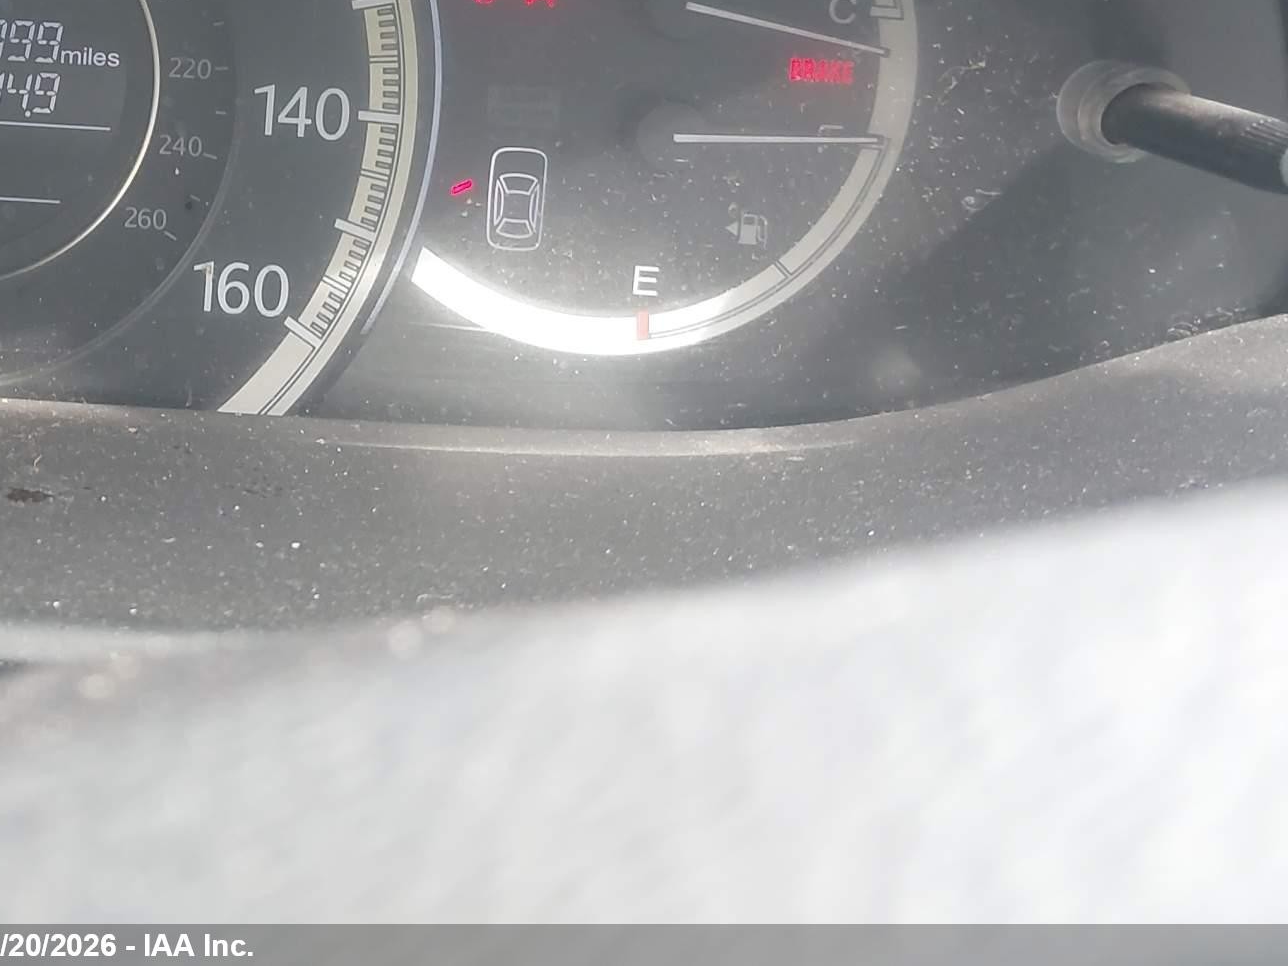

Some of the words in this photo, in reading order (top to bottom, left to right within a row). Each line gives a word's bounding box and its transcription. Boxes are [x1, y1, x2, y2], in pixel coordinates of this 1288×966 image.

[60, 46, 120, 67] miles
[168, 57, 211, 80] 220
[789, 57, 854, 84] BRAKE
[254, 84, 350, 141] 140
[159, 134, 202, 157] 240
[124, 206, 167, 231] 260
[193, 261, 289, 317] 160
[632, 265, 660, 297] E
